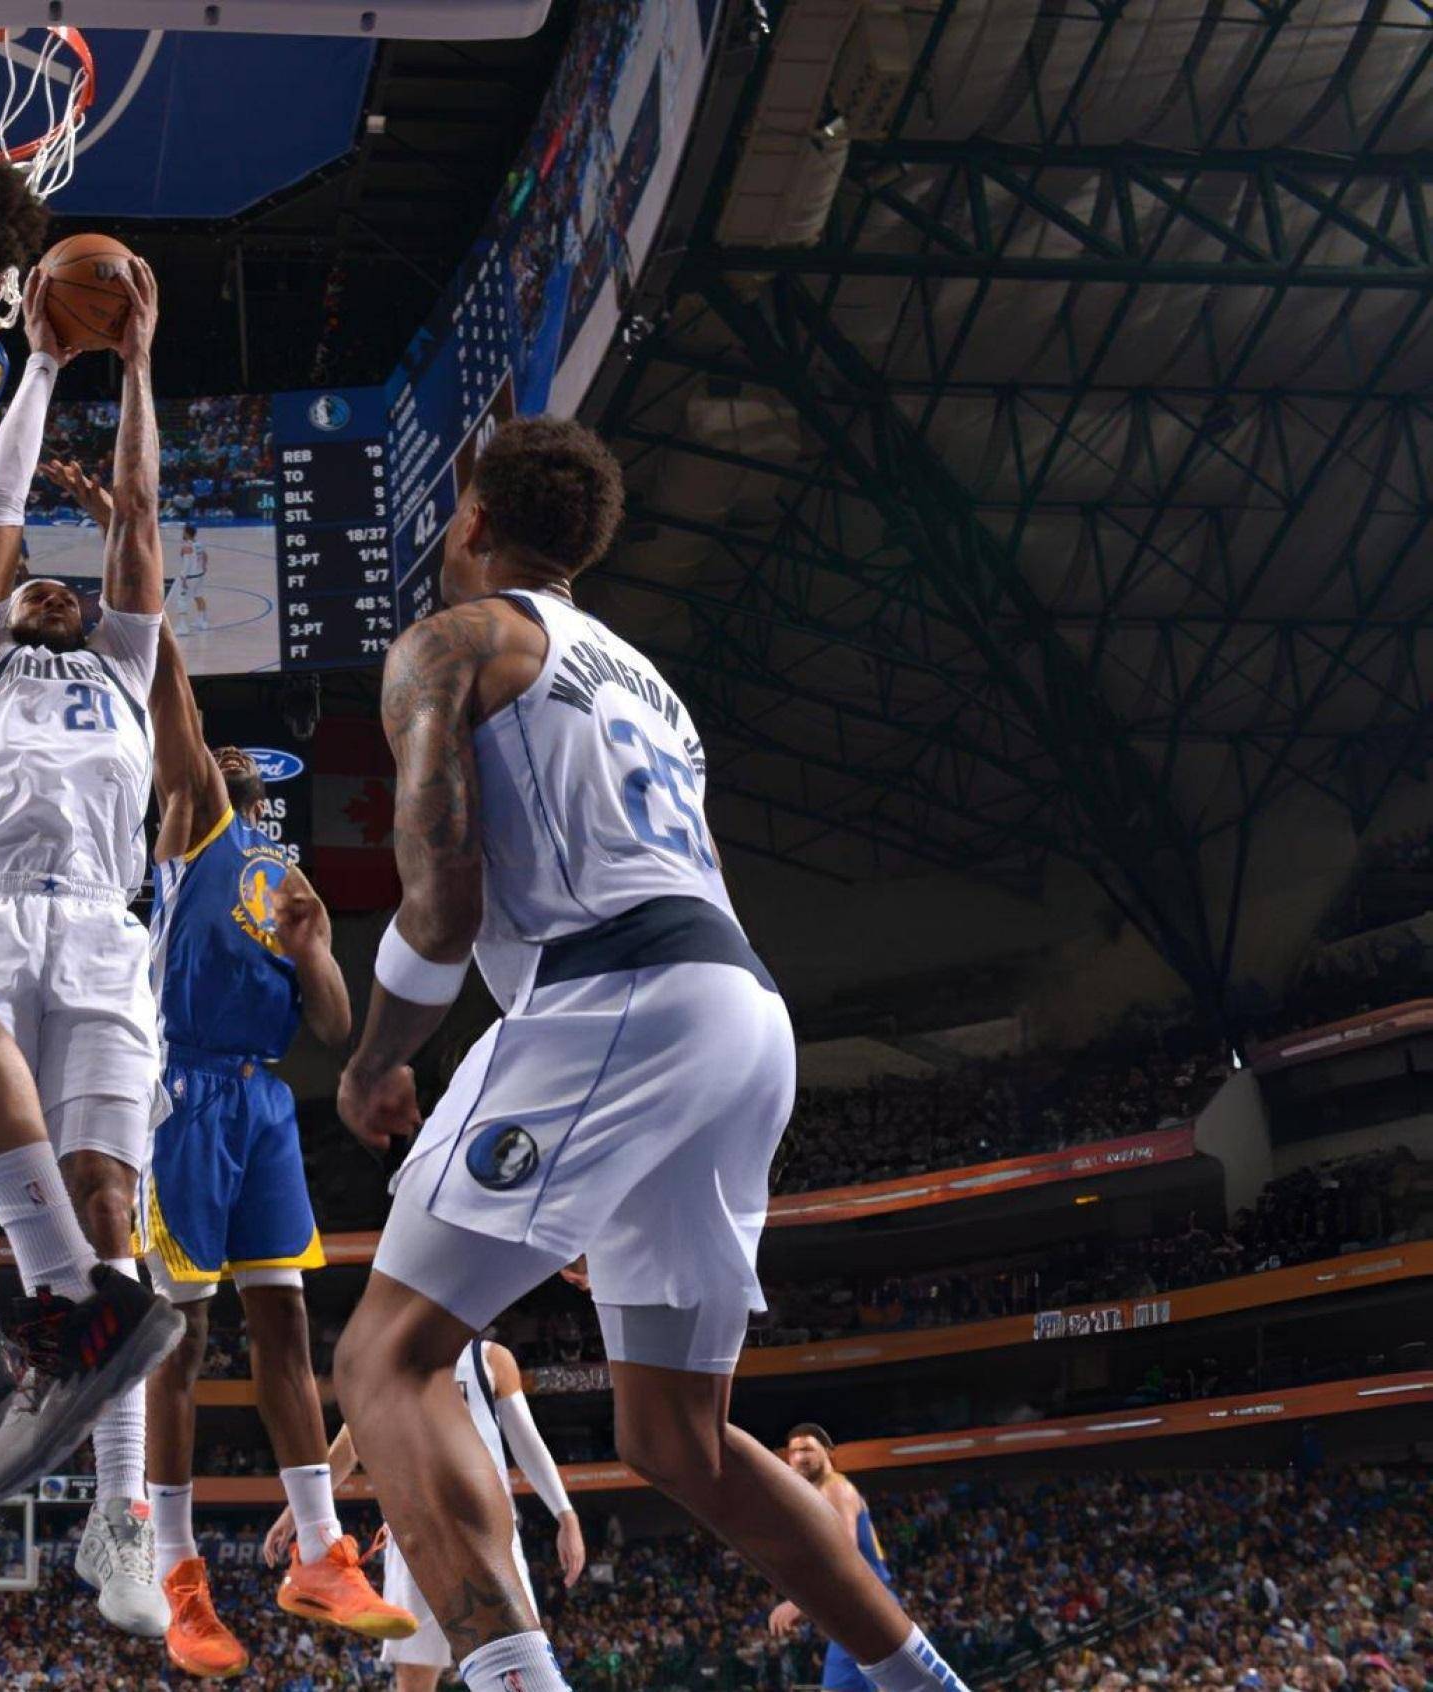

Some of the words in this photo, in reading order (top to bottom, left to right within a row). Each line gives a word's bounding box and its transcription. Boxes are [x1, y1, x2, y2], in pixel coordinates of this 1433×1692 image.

[283, 450, 312, 464] REB
[365, 445, 383, 458] 19
[284, 470, 304, 482] TO
[373, 465, 383, 477] 8
[284, 490, 314, 504] BLK
[374, 486, 384, 498] 8
[285, 509, 312, 522] STL
[376, 504, 386, 516] 3
[415, 501, 436, 546] 42
[286, 535, 307, 547] FG
[346, 528, 387, 542] 18/37
[287, 553, 320, 566] 3-PT
[359, 549, 388, 562] 1/14
[288, 575, 305, 587] FT
[365, 570, 389, 583] 5/7
[289, 604, 309, 616] FG
[290, 623, 323, 636] 3-PT
[290, 646, 309, 658] FT
[547, 641, 682, 730] WASHINGTON
[64, 682, 117, 731] 21
